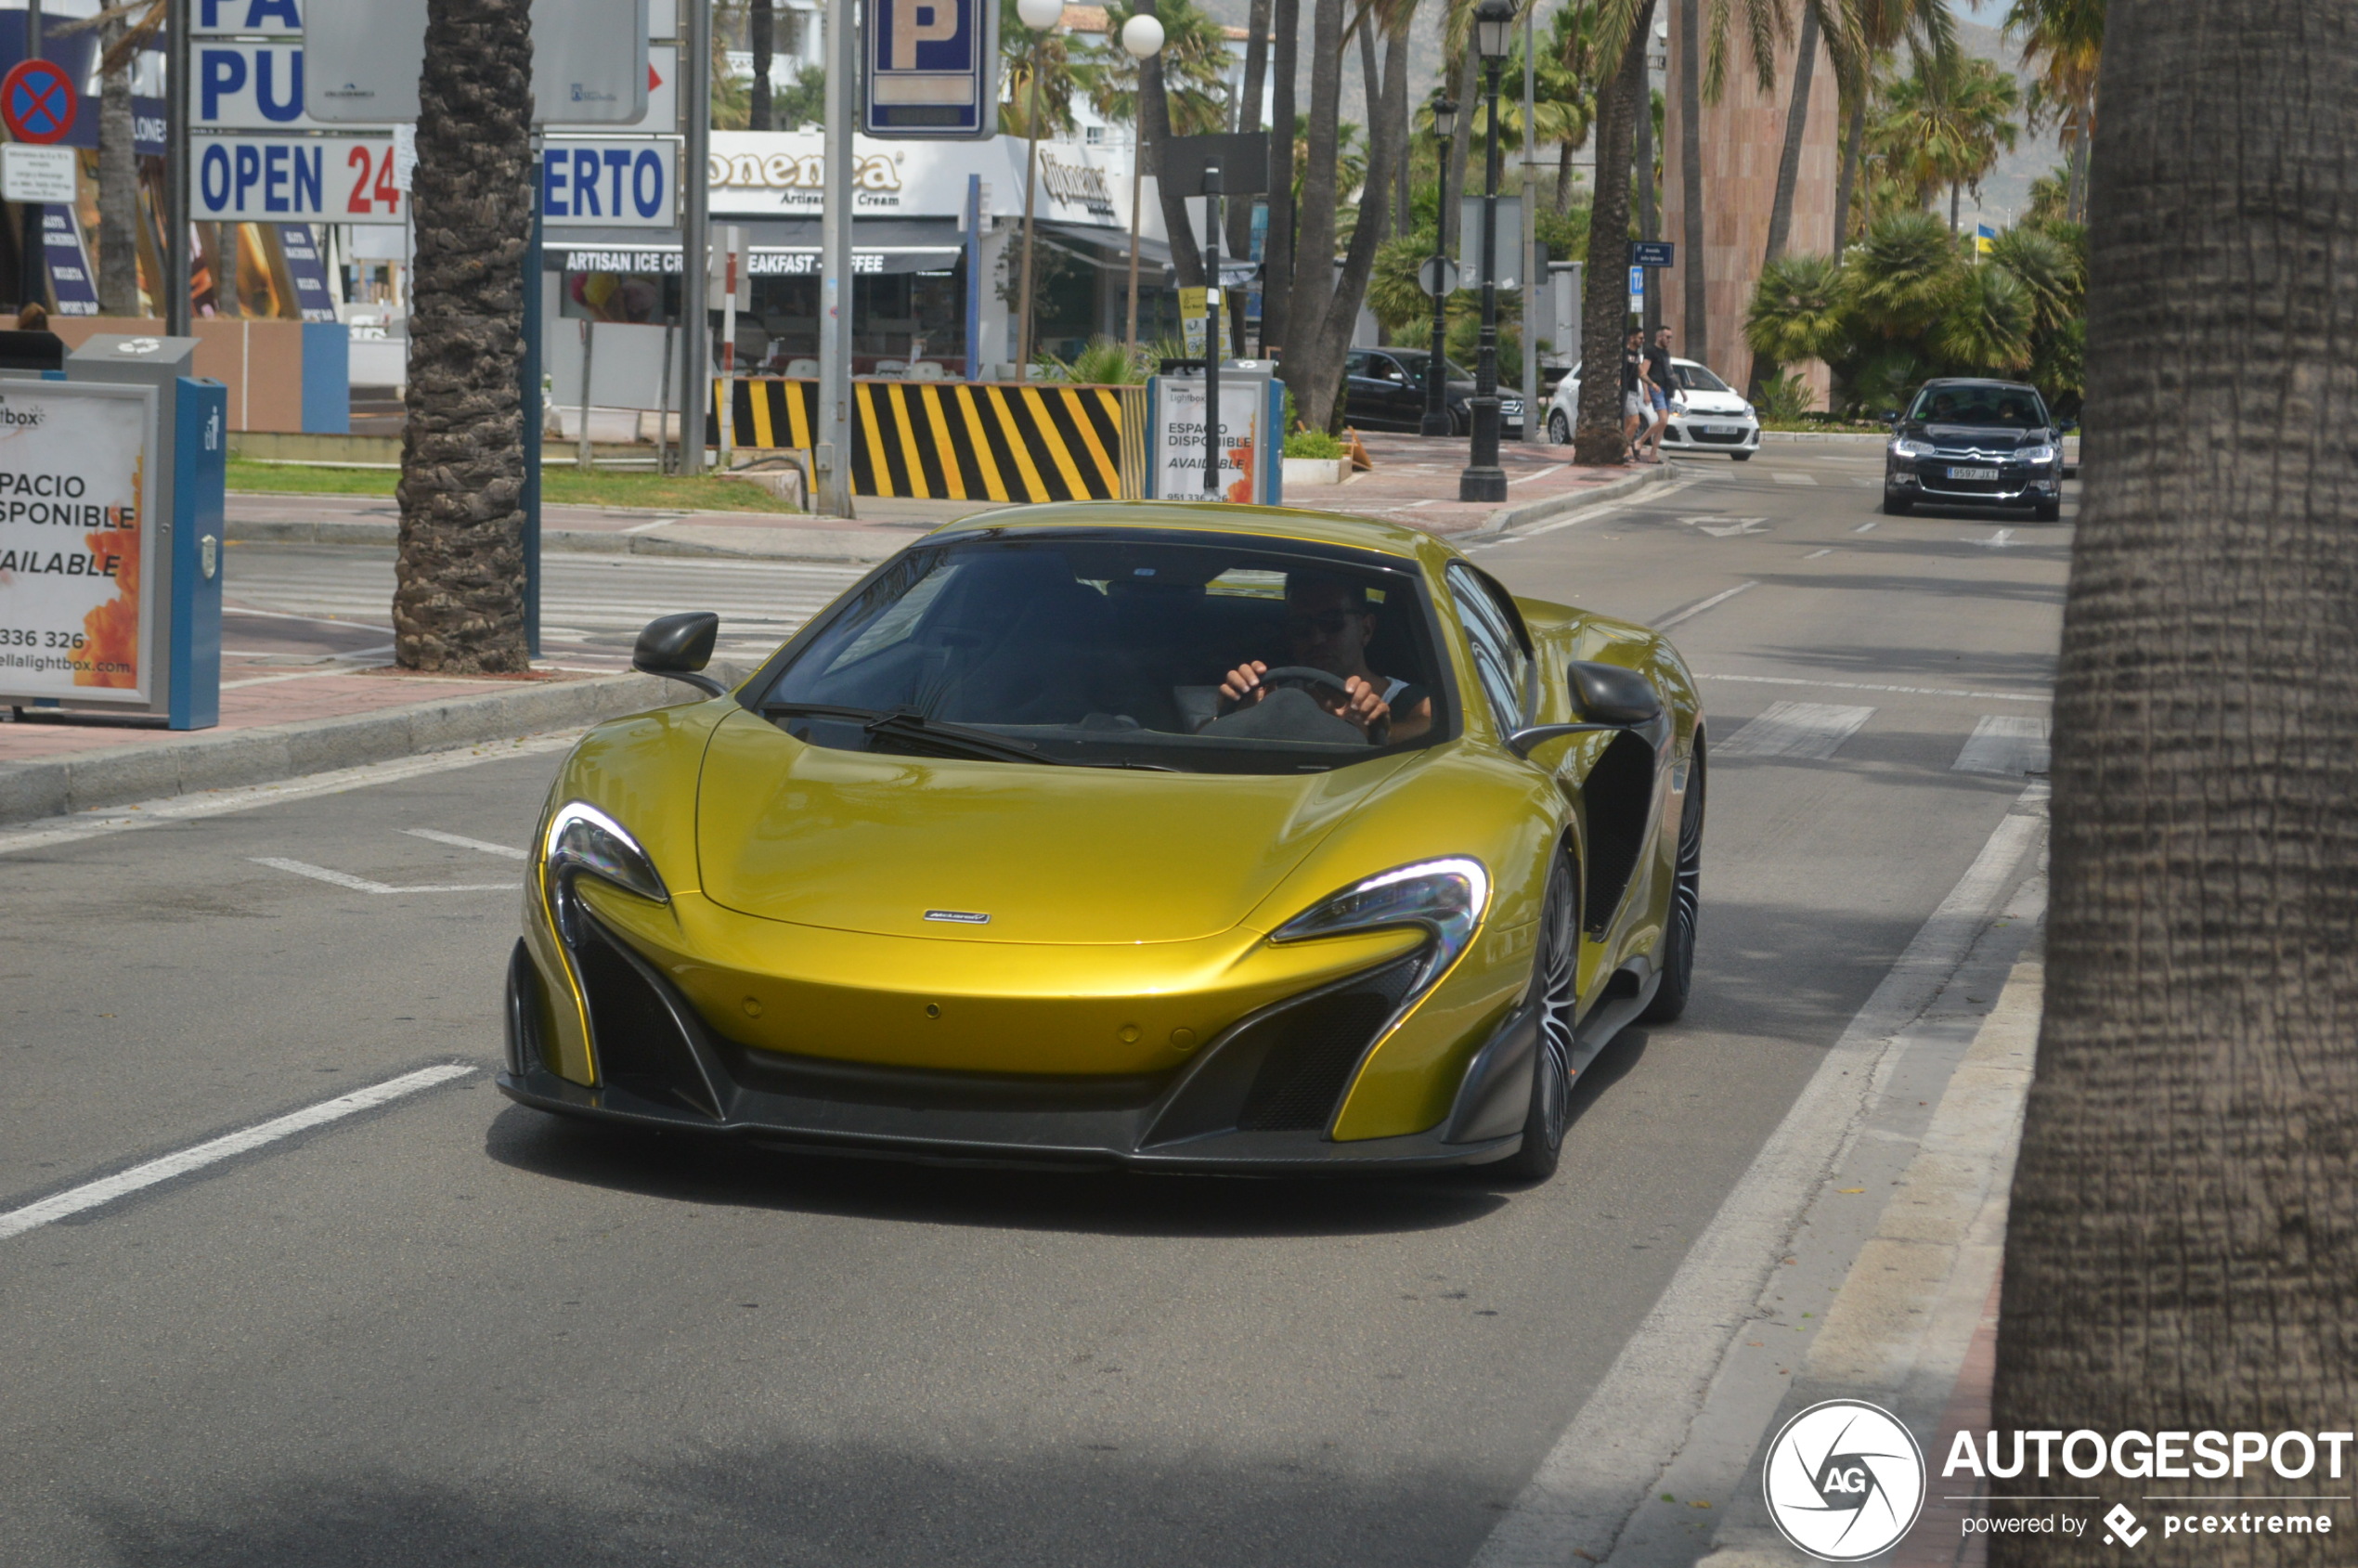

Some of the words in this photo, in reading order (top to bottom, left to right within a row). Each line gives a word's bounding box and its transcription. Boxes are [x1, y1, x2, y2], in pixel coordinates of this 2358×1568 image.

[891, 0, 957, 70] P
[201, 145, 322, 212] OPEN
[347, 146, 399, 214] 24
[543, 149, 664, 218] ERTO
[858, 193, 900, 206] Cream
[566, 252, 630, 272] ARTISAN
[635, 253, 660, 272] ICE
[1168, 422, 1228, 434] ESPAO
[1168, 434, 1252, 447] DISPIBLE
[1168, 458, 1245, 470] AVAILBLE
[0, 473, 85, 499] PACIO
[0, 550, 122, 577] AILABLE
[0, 628, 37, 647] 336
[45, 630, 84, 649] 326
